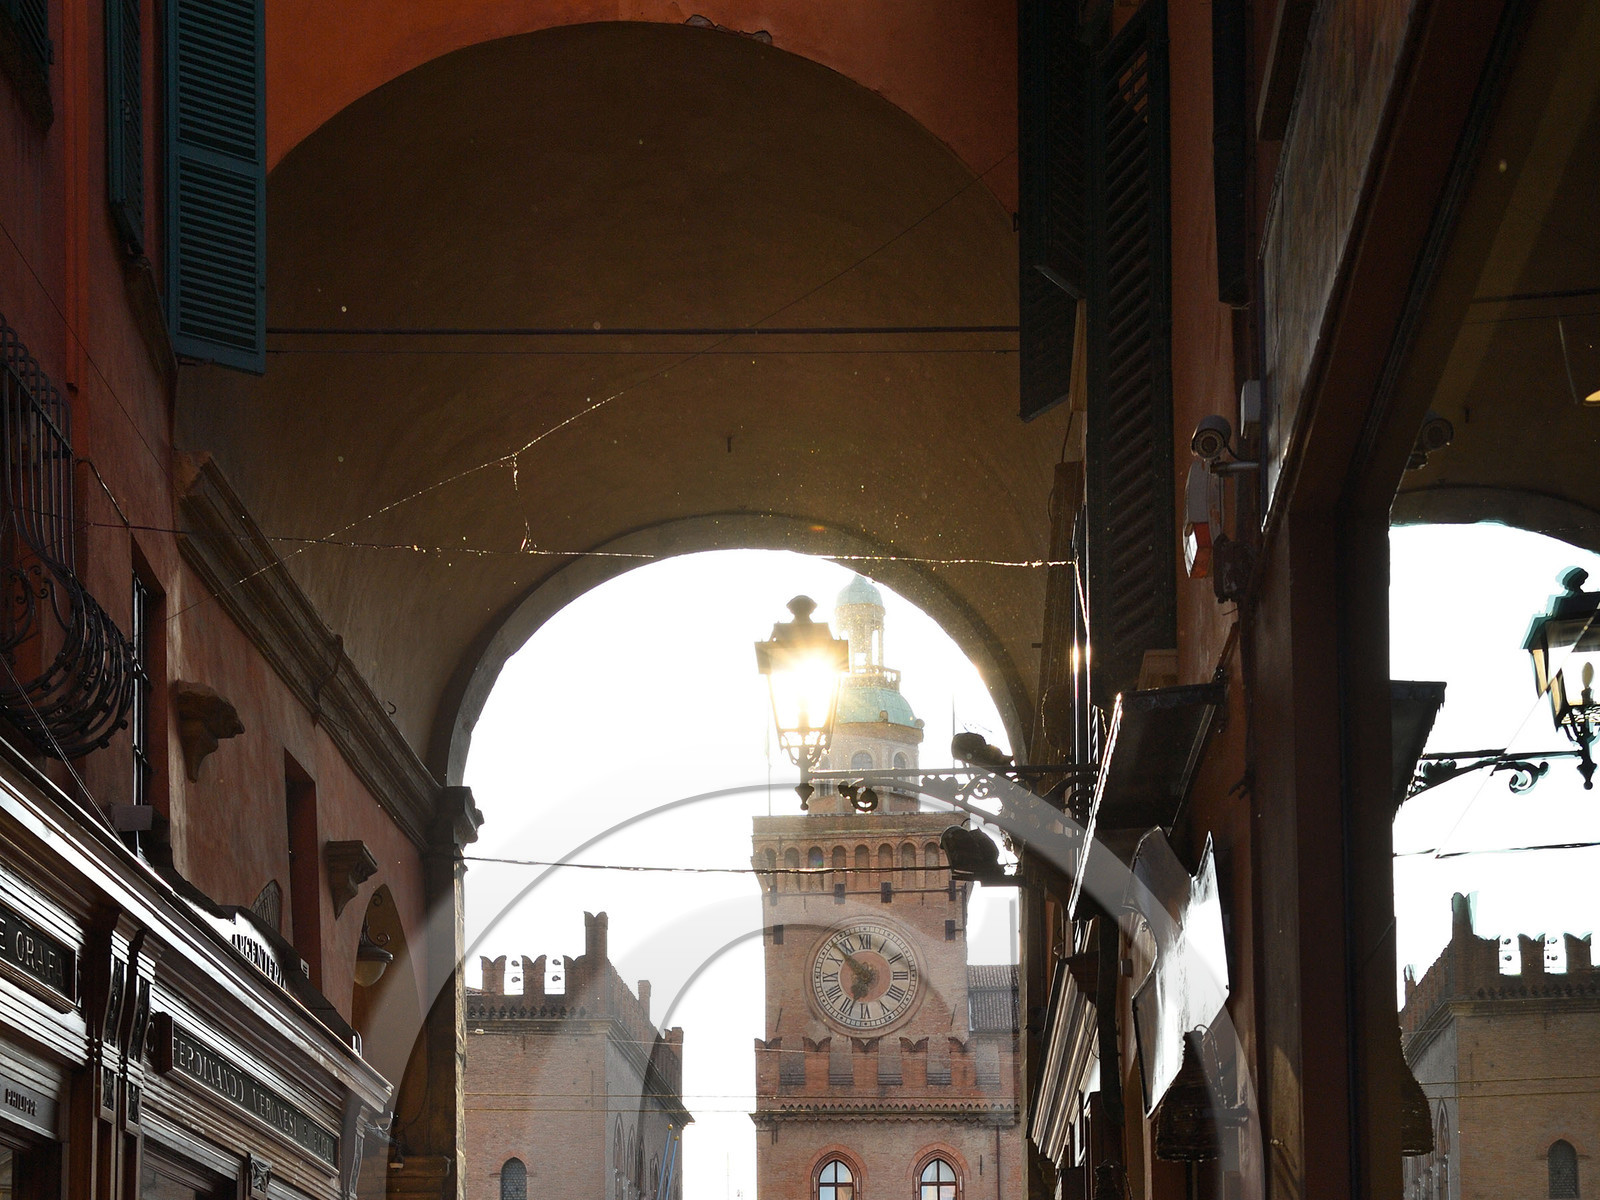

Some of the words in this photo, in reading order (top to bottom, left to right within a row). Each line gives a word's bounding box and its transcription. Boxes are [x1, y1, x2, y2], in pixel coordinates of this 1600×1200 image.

[15, 930, 64, 987] ORAFA
[859, 934, 871, 950] XII
[860, 1003, 871, 1019] VI
[173, 1036, 244, 1102] FERDINANDO
[252, 1088, 297, 1137] VERONESI
